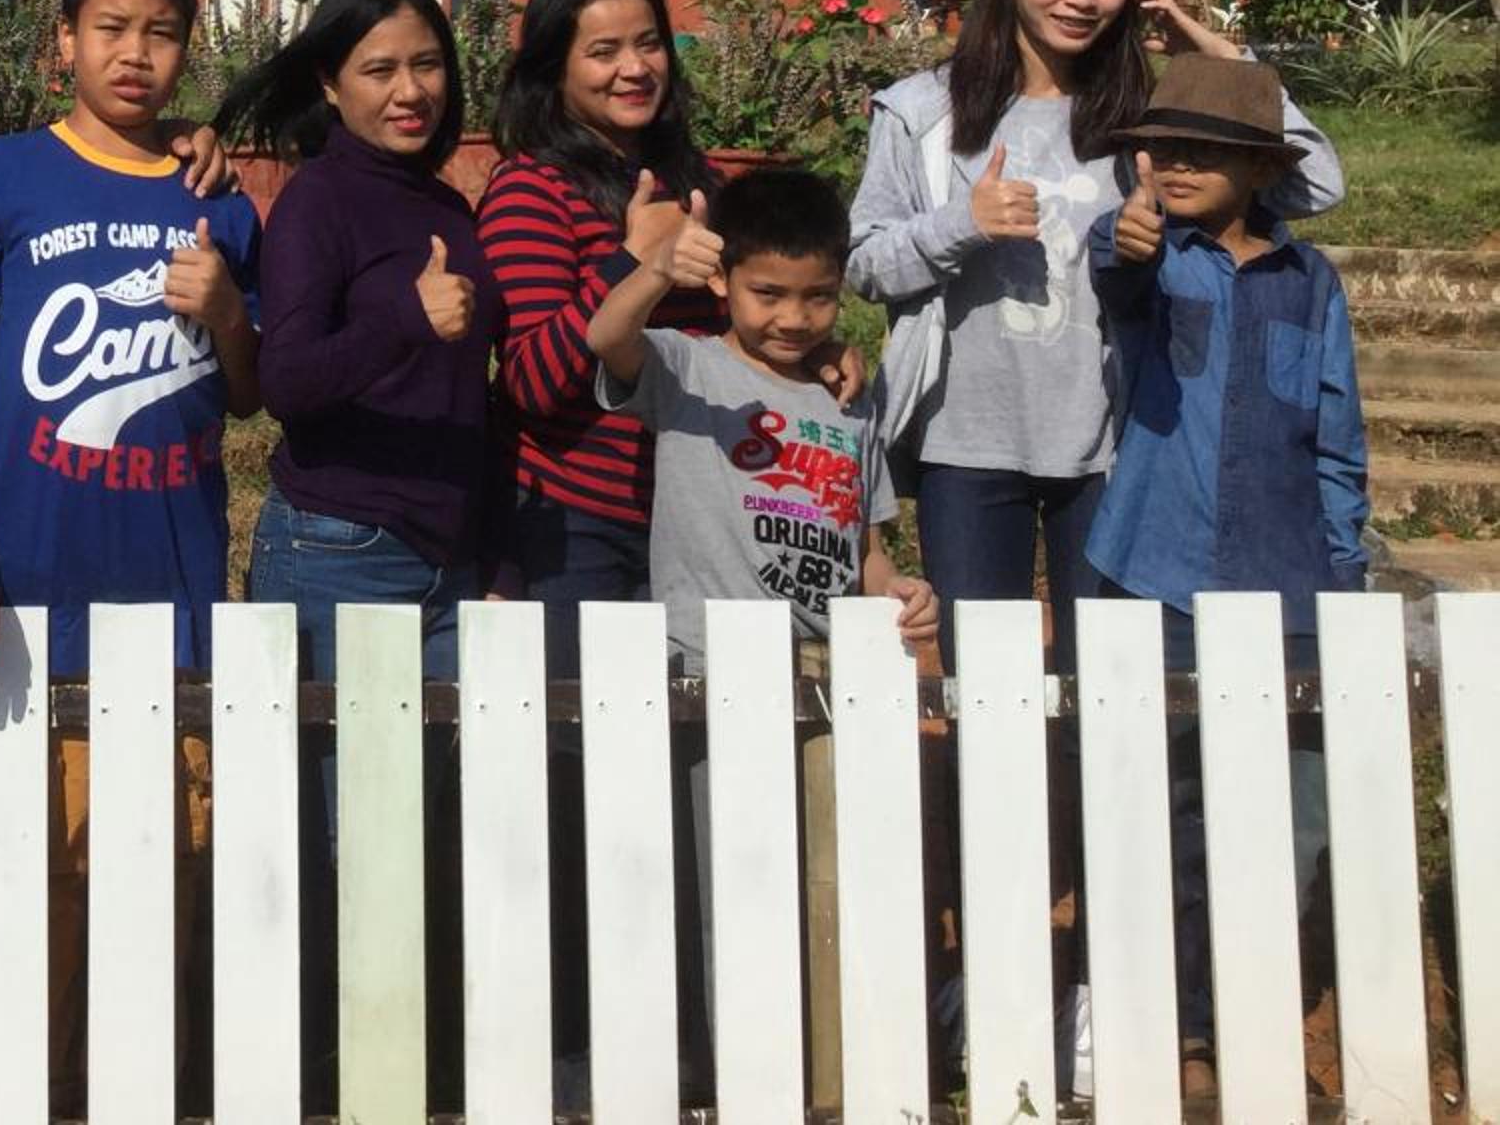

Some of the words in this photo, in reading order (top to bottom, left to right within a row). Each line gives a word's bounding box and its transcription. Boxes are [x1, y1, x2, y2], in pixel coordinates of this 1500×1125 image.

[29, 222, 97, 266] FOREST
[107, 222, 161, 250] CAMP
[165, 226, 199, 251] ASS
[795, 554, 833, 590] 68
